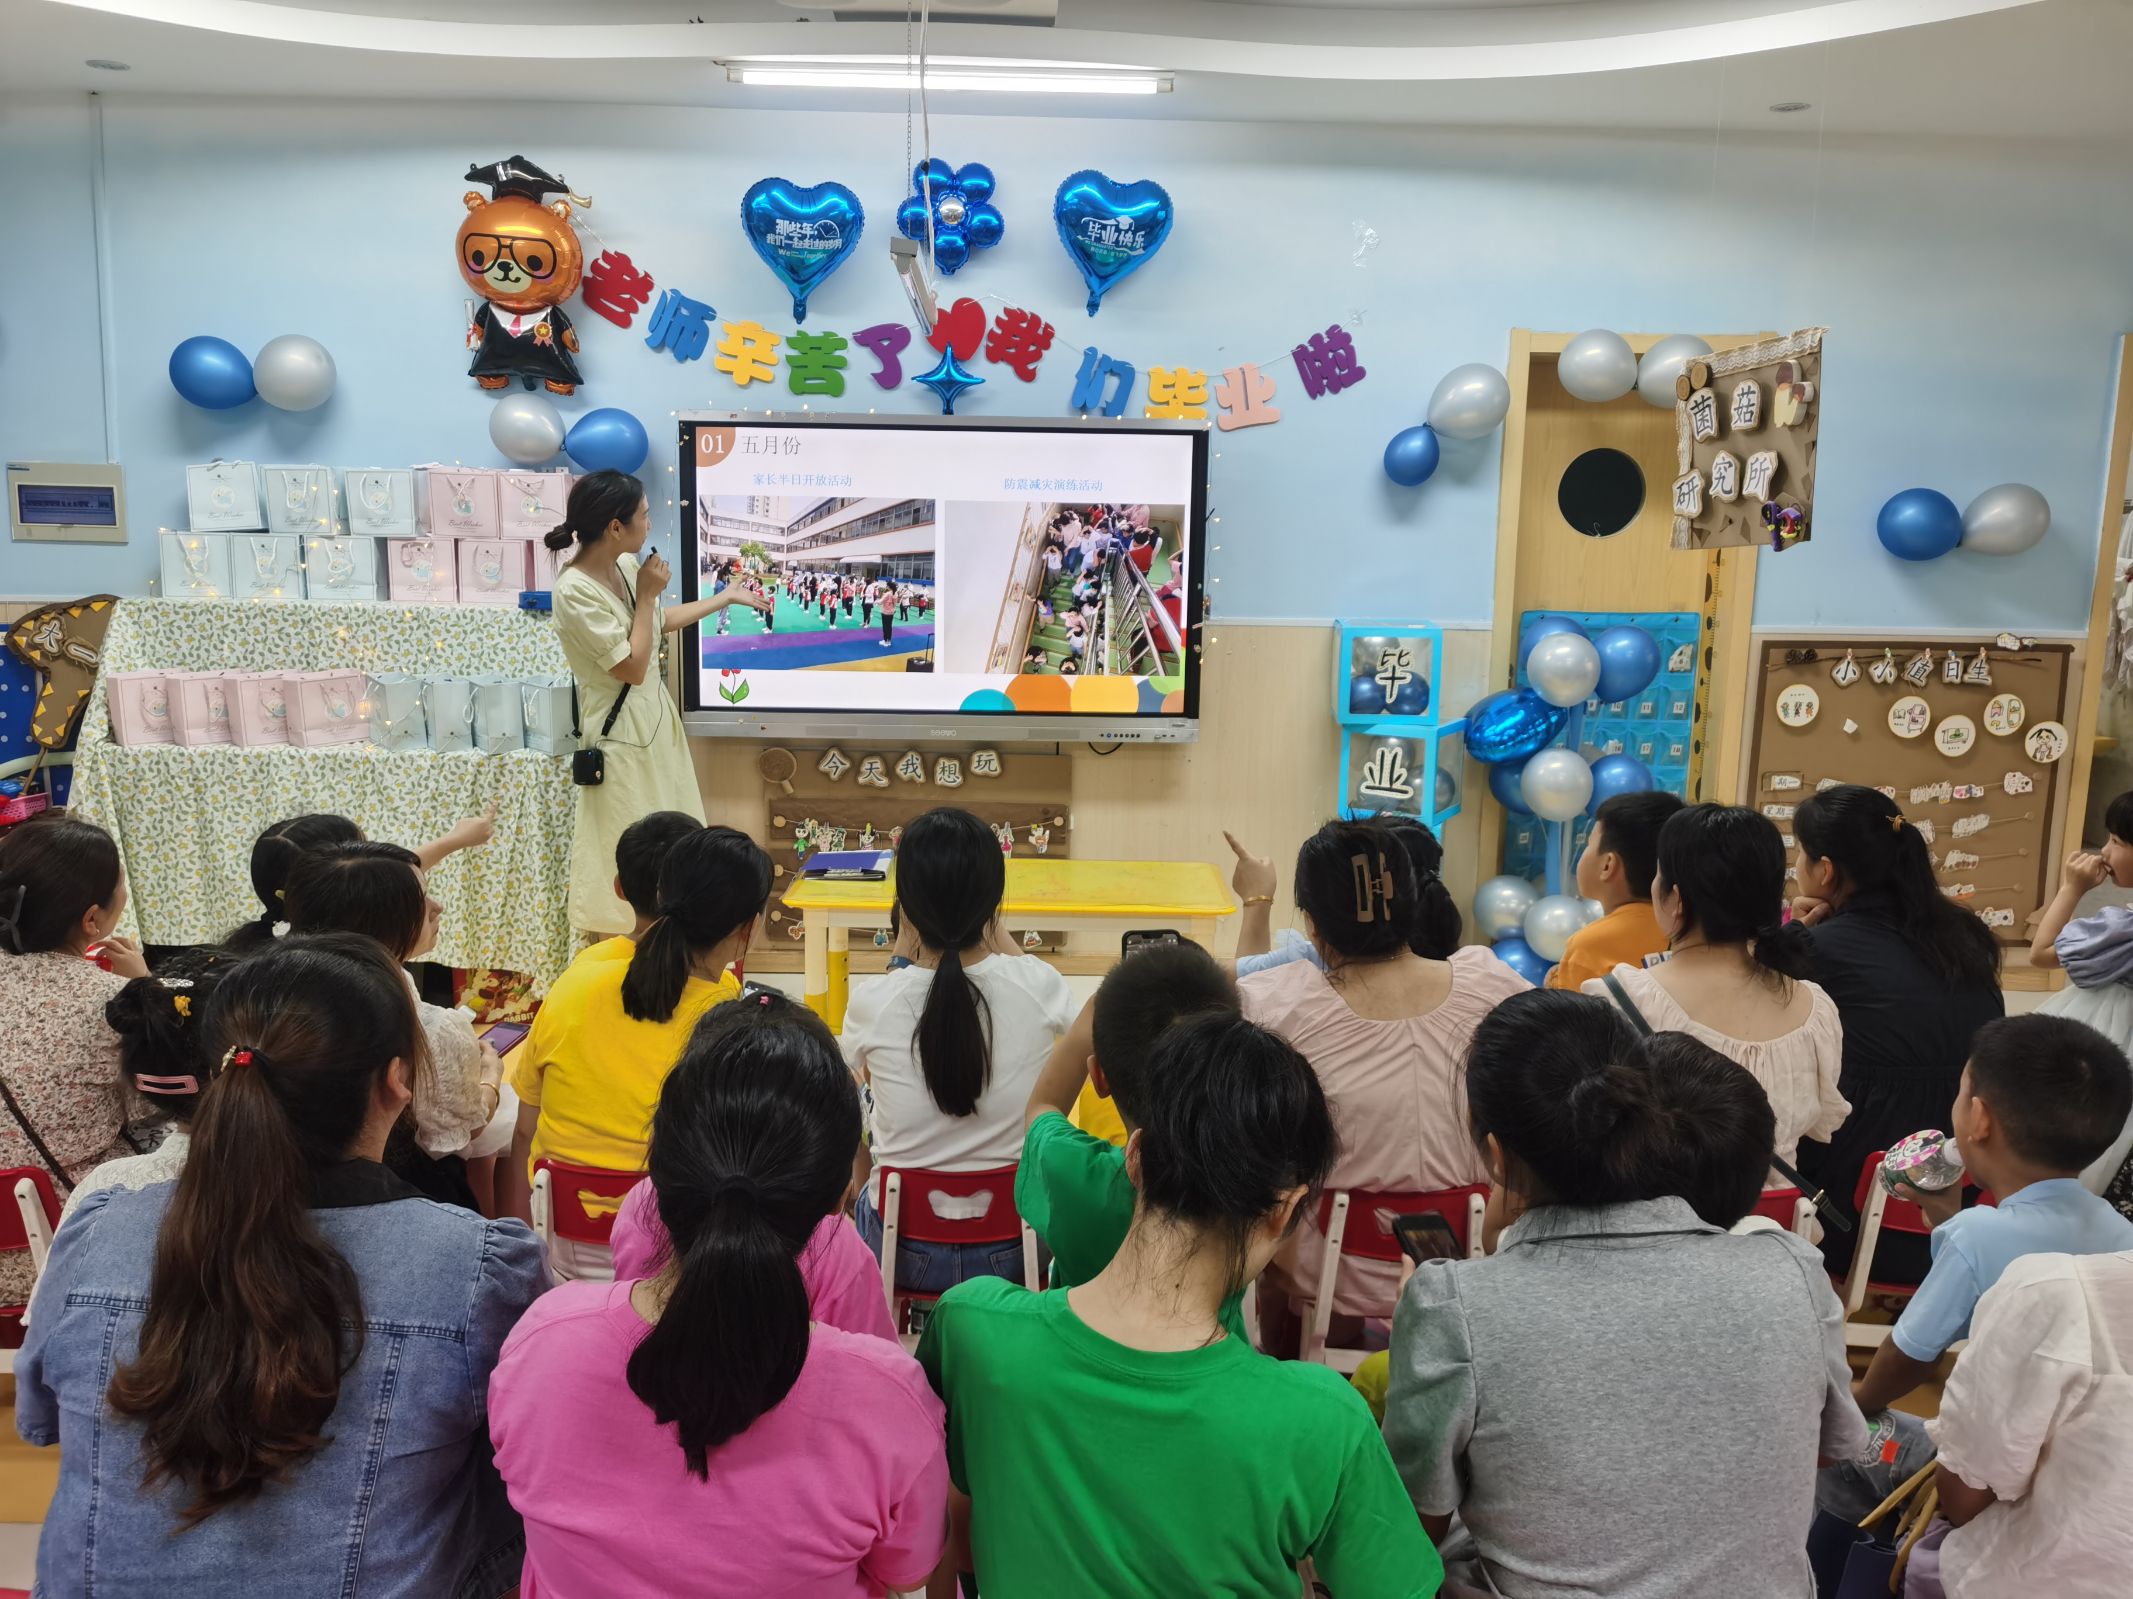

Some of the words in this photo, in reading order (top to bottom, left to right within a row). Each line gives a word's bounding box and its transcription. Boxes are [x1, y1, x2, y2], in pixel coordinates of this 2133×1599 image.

[1088, 221, 1146, 249] 毕业快乐
[582, 248, 912, 397] 老师辛苦了
[985, 306, 1367, 432] 我们毕业啦
[1690, 385, 1757, 437] 菌菇
[700, 432, 726, 454] 01
[741, 435, 802, 456] 五月份
[752, 472, 853, 488] 家长半日开放活动
[1003, 477, 1105, 493] 防震减灾演练活动
[1676, 456, 1770, 510] 研究所
[1835, 657, 1991, 682] 小小值日生
[1675, 703, 1684, 711] 12
[823, 752, 999, 785] 今天我想玩
